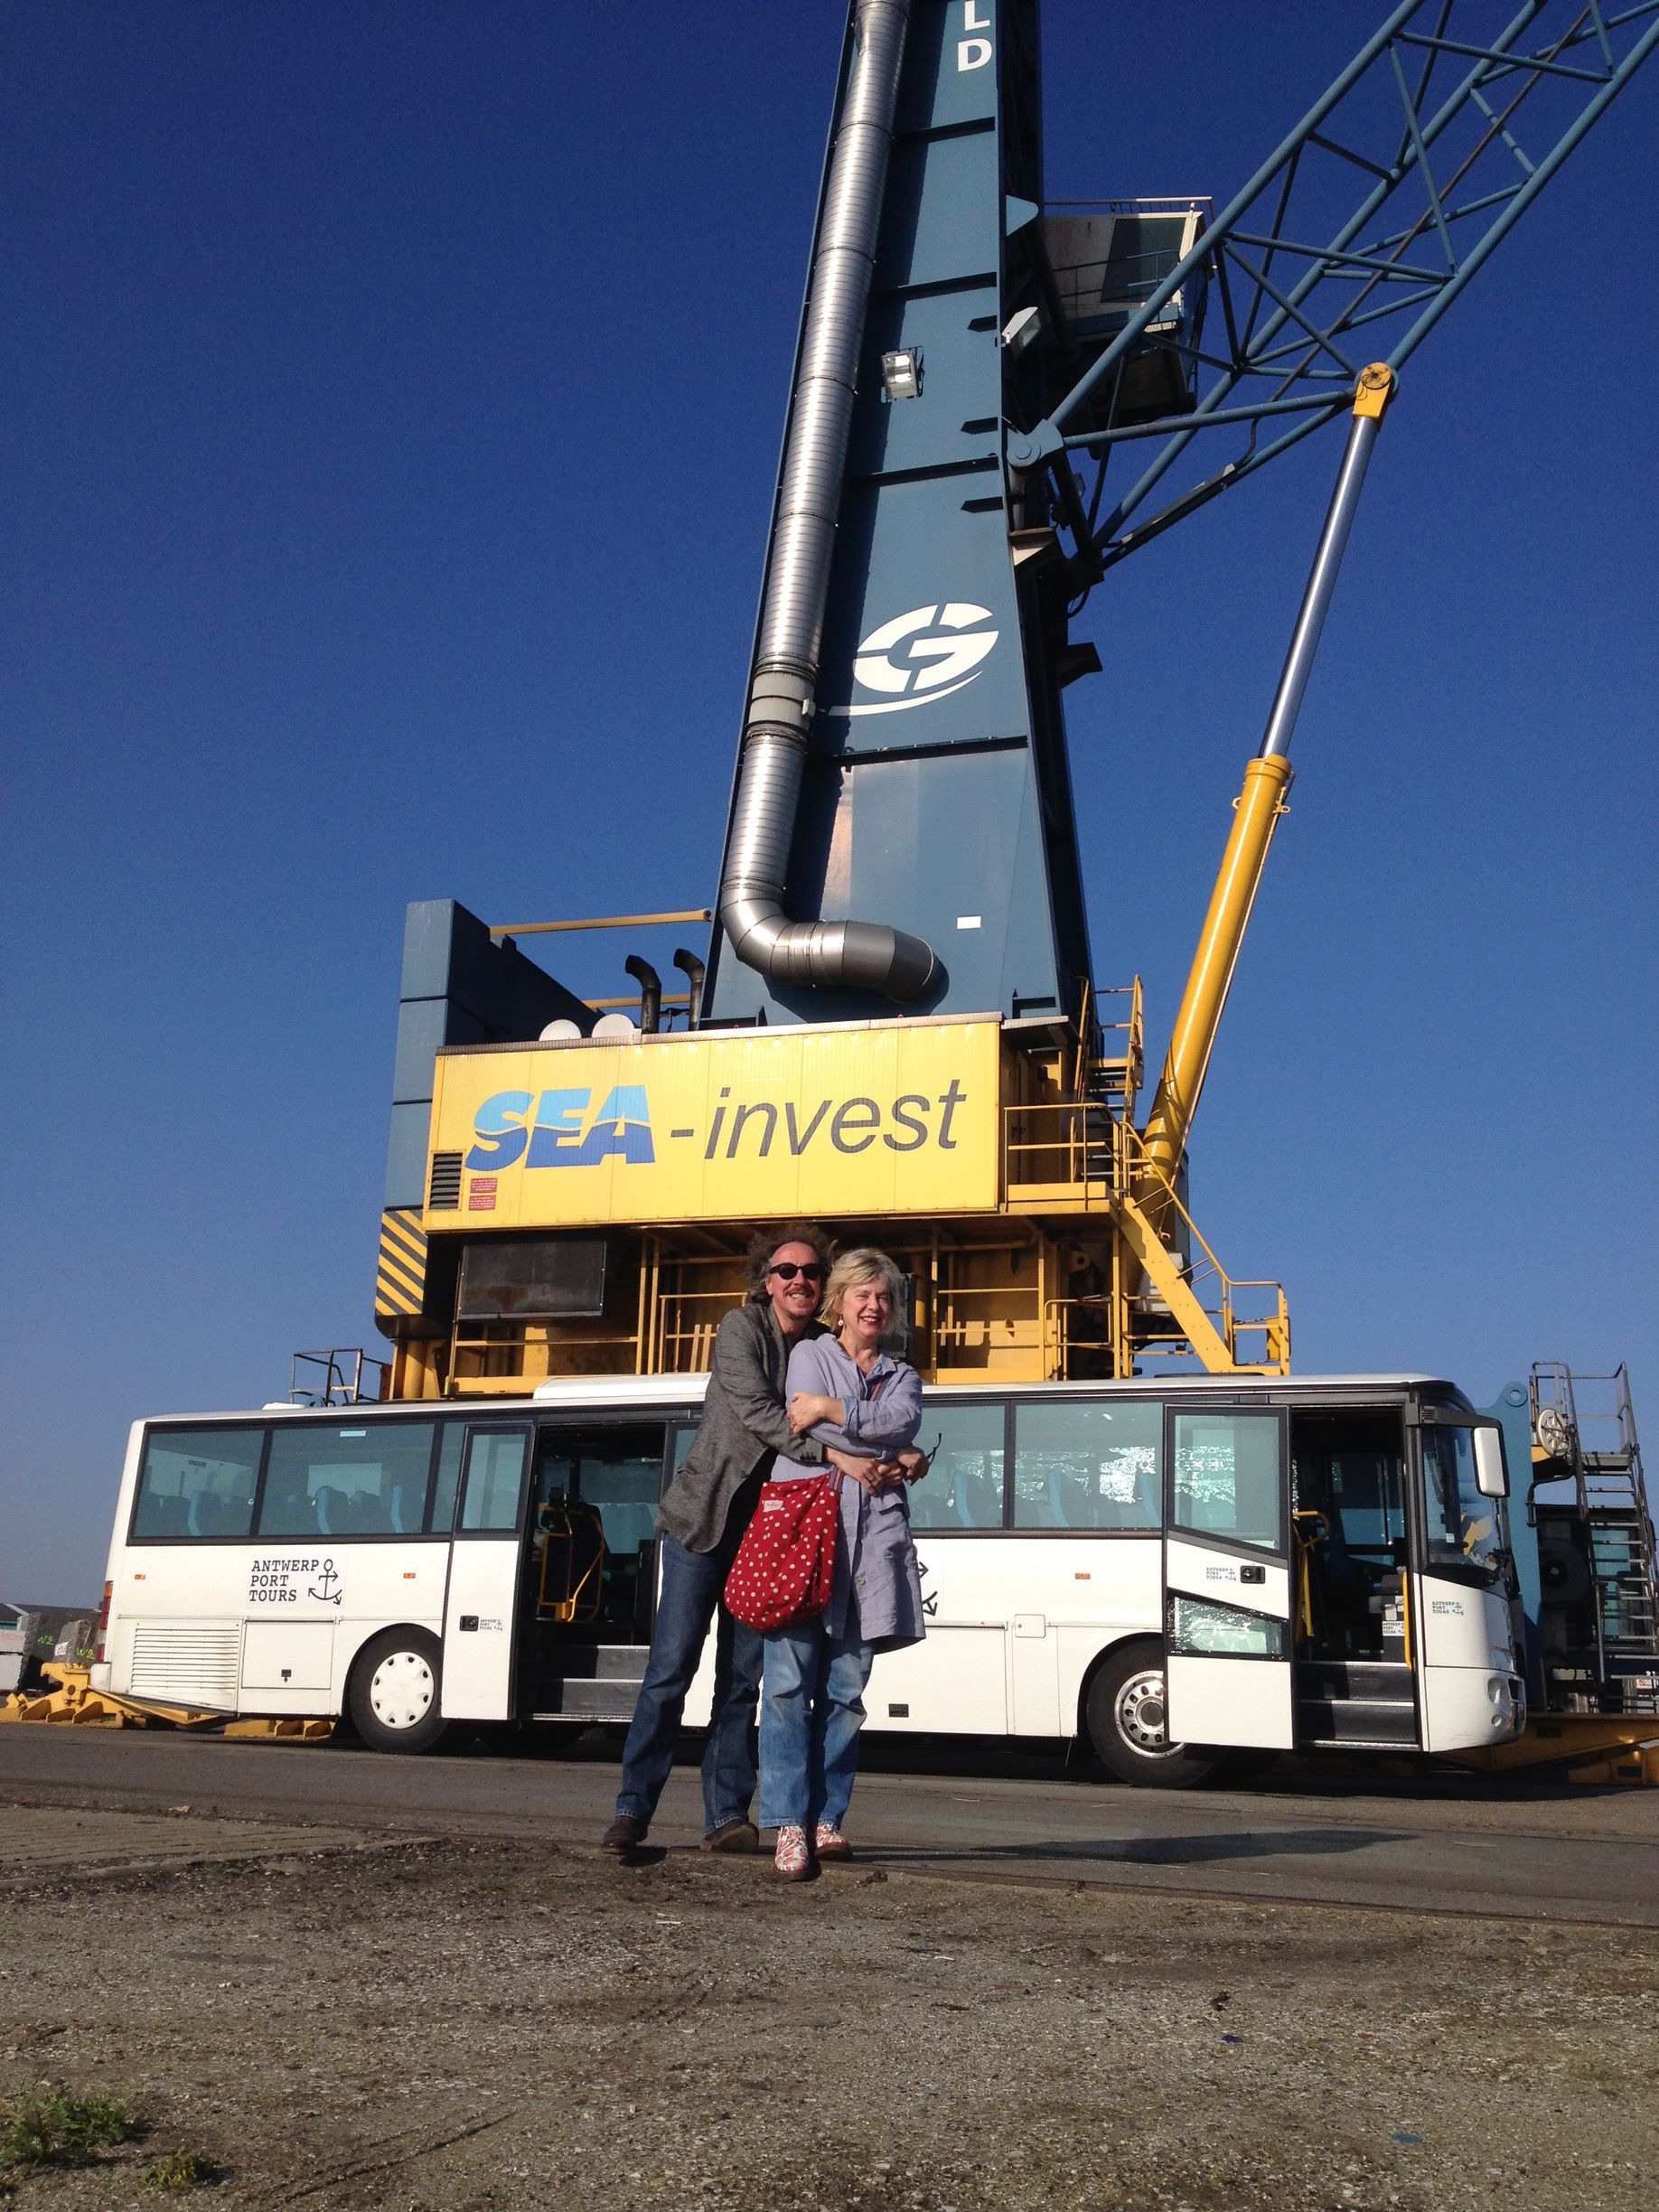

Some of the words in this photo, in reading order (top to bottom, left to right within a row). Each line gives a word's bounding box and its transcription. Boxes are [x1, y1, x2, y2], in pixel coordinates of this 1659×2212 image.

[251, 1559, 320, 1572] ANTWERP
[250, 1574, 289, 1587] PORT
[248, 1589, 297, 1602] TOURS
